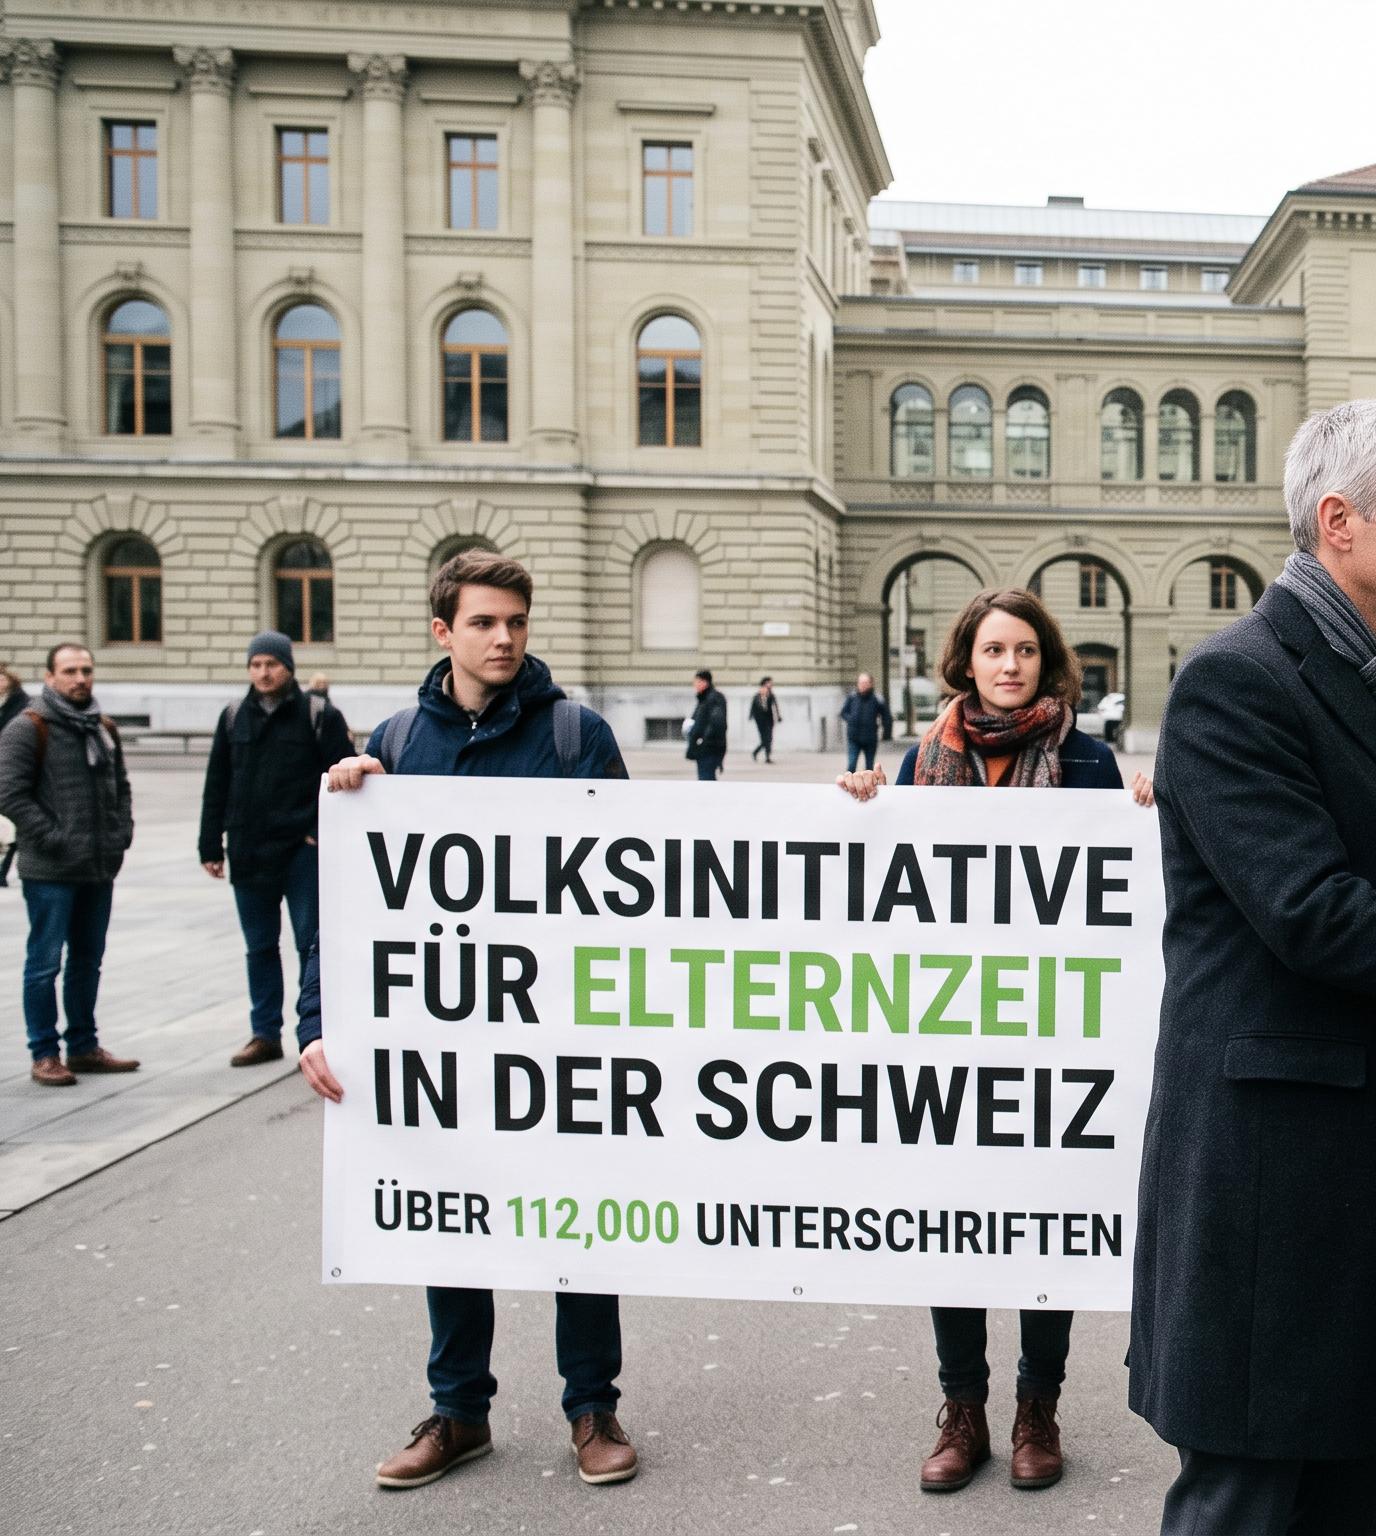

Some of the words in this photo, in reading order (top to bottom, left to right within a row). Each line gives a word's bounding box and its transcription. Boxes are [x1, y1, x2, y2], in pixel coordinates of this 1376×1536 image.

[367, 832, 1133, 927] VOLKSINITIATIVE
[373, 923, 540, 1023] FÜR
[574, 946, 1122, 1038] ELTERNZEIT
[374, 1049, 458, 1129] IN
[494, 1053, 664, 1137] DER
[696, 1060, 1115, 1149] SCHWEIZ
[374, 1178, 491, 1235] ÜBER
[507, 1196, 679, 1249] 112,000
[697, 1203, 1122, 1256] UNTERSCHRIFTEN
